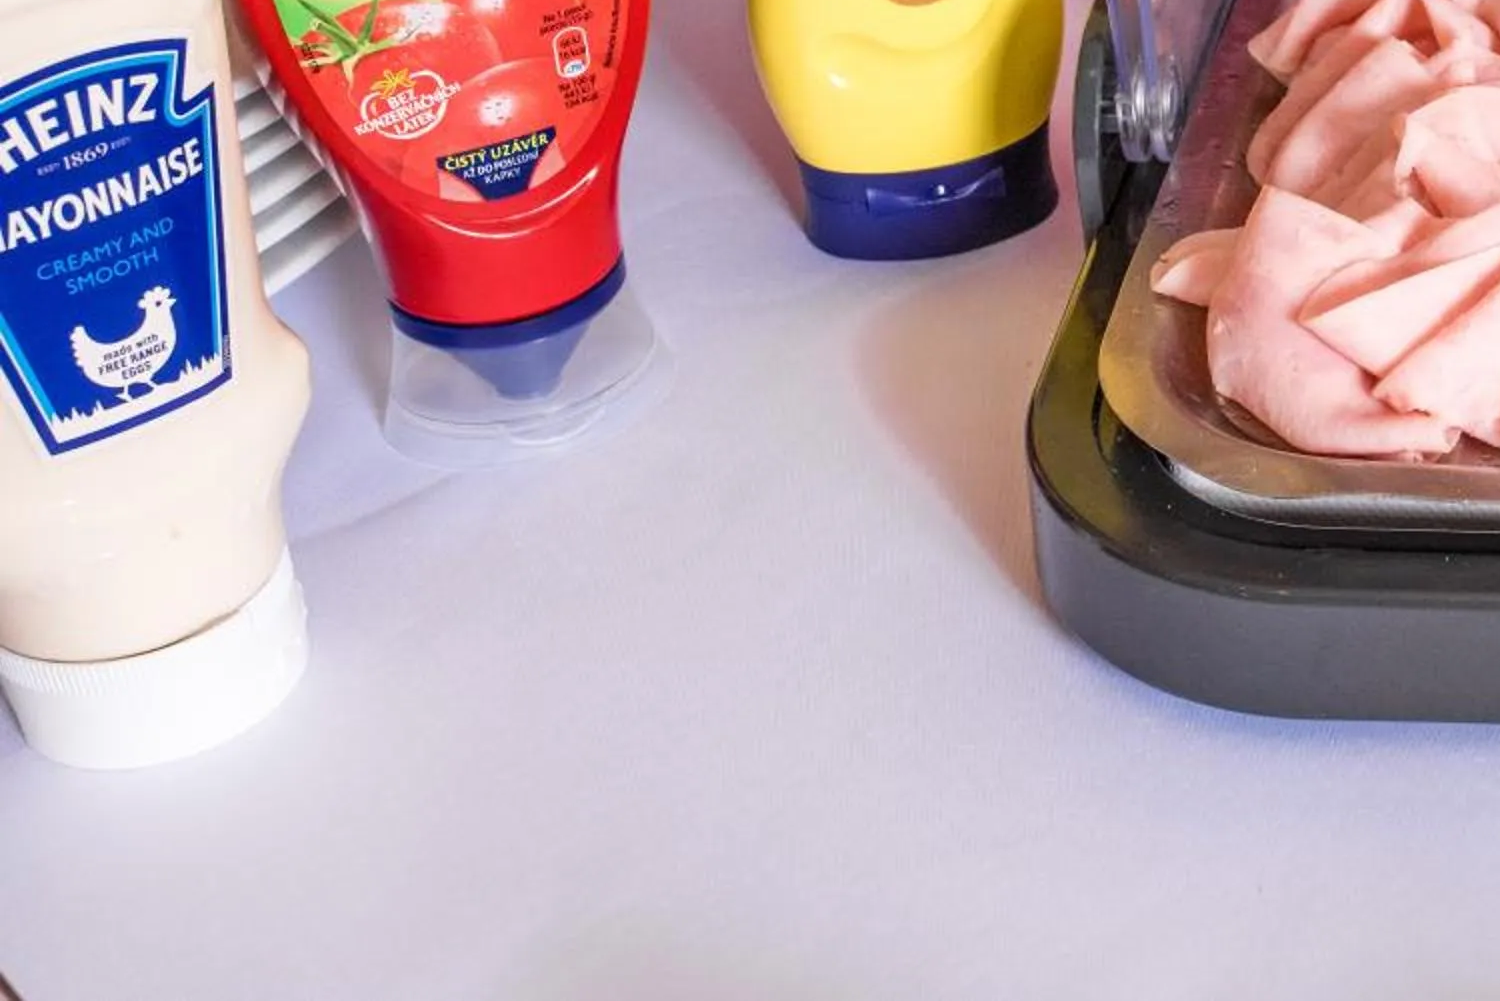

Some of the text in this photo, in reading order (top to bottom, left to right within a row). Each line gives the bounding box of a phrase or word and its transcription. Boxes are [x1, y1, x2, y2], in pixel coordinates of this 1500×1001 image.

[0, 73, 158, 174] HEINZ
[63, 142, 109, 170] 1869
[0, 137, 203, 253] AYONNAISE
[36, 216, 174, 280] CREAMY AND
[65, 246, 159, 295] SMOOTH
[98, 340, 169, 376] FREE RANGE
[103, 333, 159, 361] made with
[121, 360, 152, 380] EGGS
